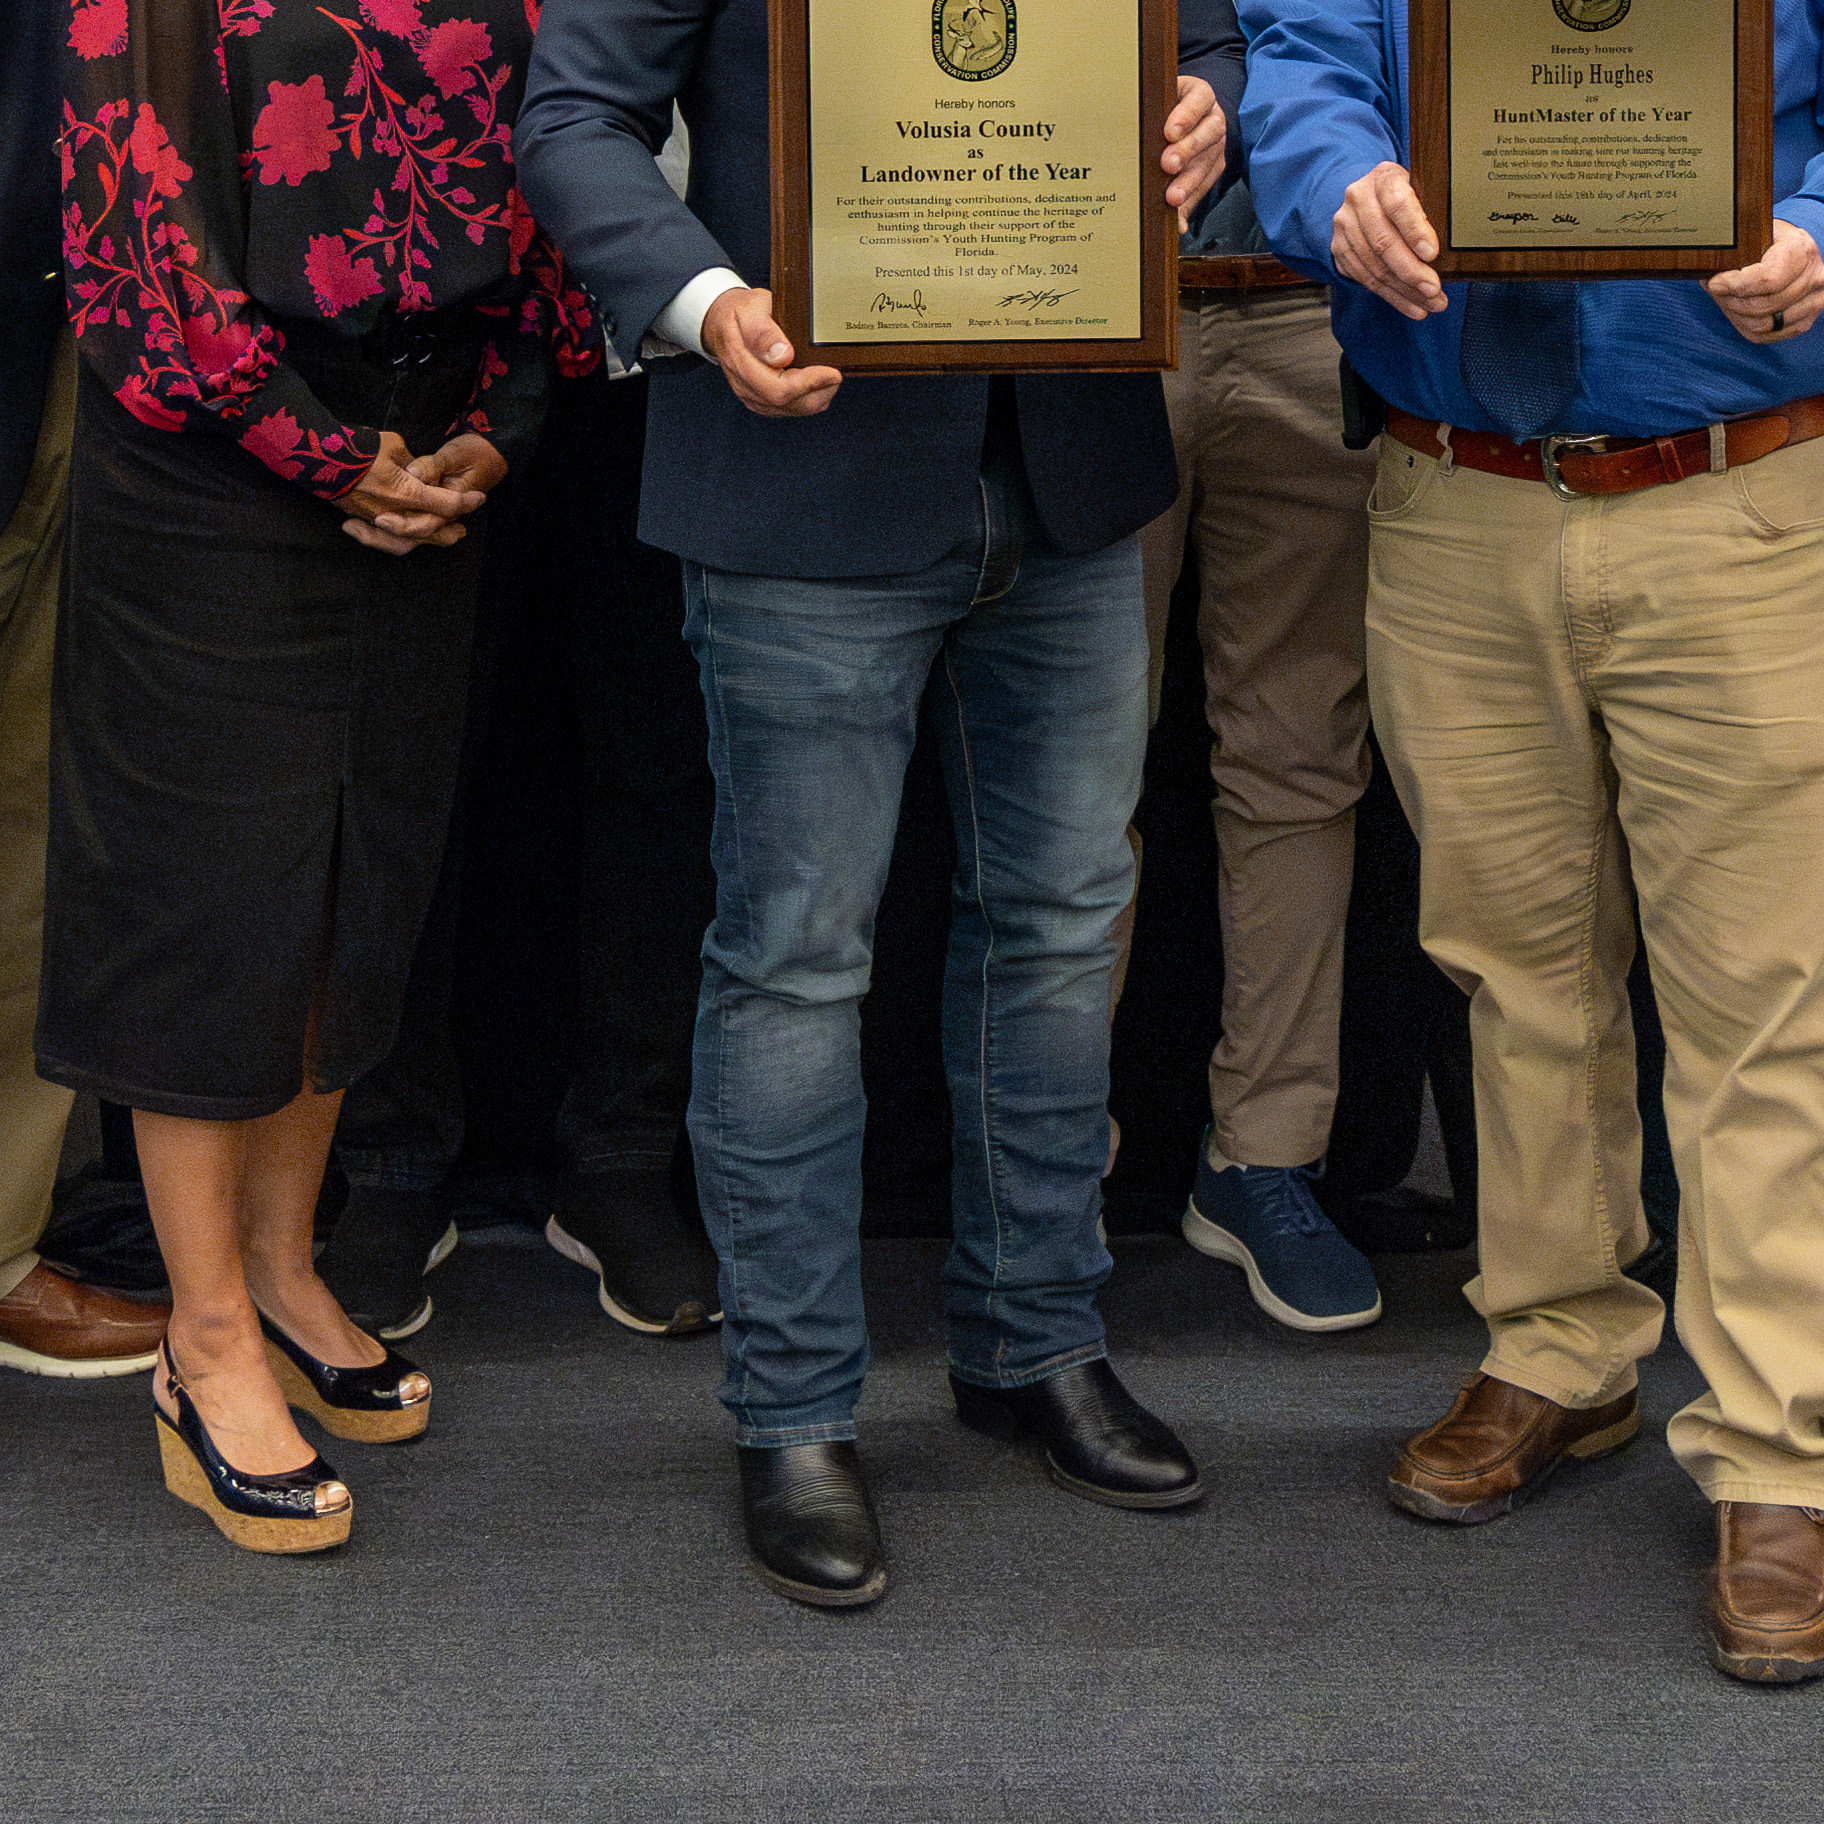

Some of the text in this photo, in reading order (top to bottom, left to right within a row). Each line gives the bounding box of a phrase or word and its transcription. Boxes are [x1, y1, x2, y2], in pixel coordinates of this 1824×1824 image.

[934, 33, 1015, 80] CONSERVATION COMMISSION
[1551, 44, 1591, 56] Hereby
[1531, 63, 1653, 89] Philip Hughes
[935, 98, 1016, 111] Hereby honors
[1585, 94, 1598, 102] as
[1493, 107, 1692, 123] HuntMaster of the Year
[895, 120, 1056, 141] Volusia County
[968, 148, 984, 159] as
[861, 163, 1091, 184] Landowner of the Year
[837, 194, 1116, 206] For their outstanding contributions, dedication and
[848, 206, 1104, 219] enthusiasm in helping continue the heritage of
[878, 220, 1075, 233] hunting through their support of the
[859, 233, 1093, 245] Commission's Youth Hunting Program of
[955, 248, 998, 257] Florida.
[875, 264, 1078, 278] Presented this 1st day of May, 2024
